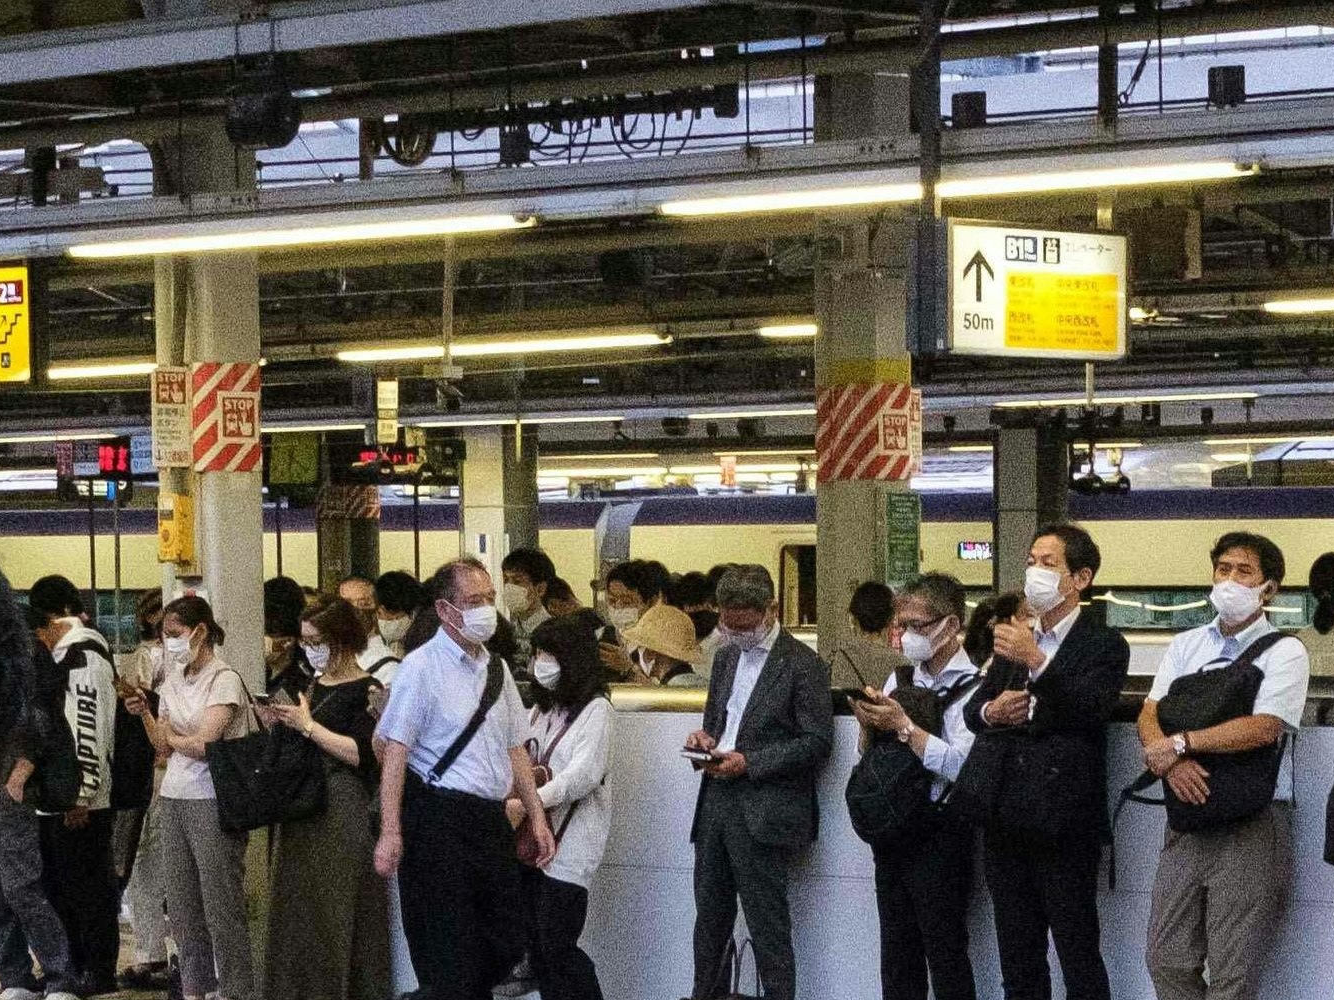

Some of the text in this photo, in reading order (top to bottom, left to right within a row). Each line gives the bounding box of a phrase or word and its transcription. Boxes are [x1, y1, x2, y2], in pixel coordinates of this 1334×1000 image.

[963, 313, 994, 331] 50m
[157, 373, 184, 382] STOP
[224, 399, 253, 410] STOP
[884, 417, 907, 426] STOP
[75, 684, 100, 790] CAPTURE
